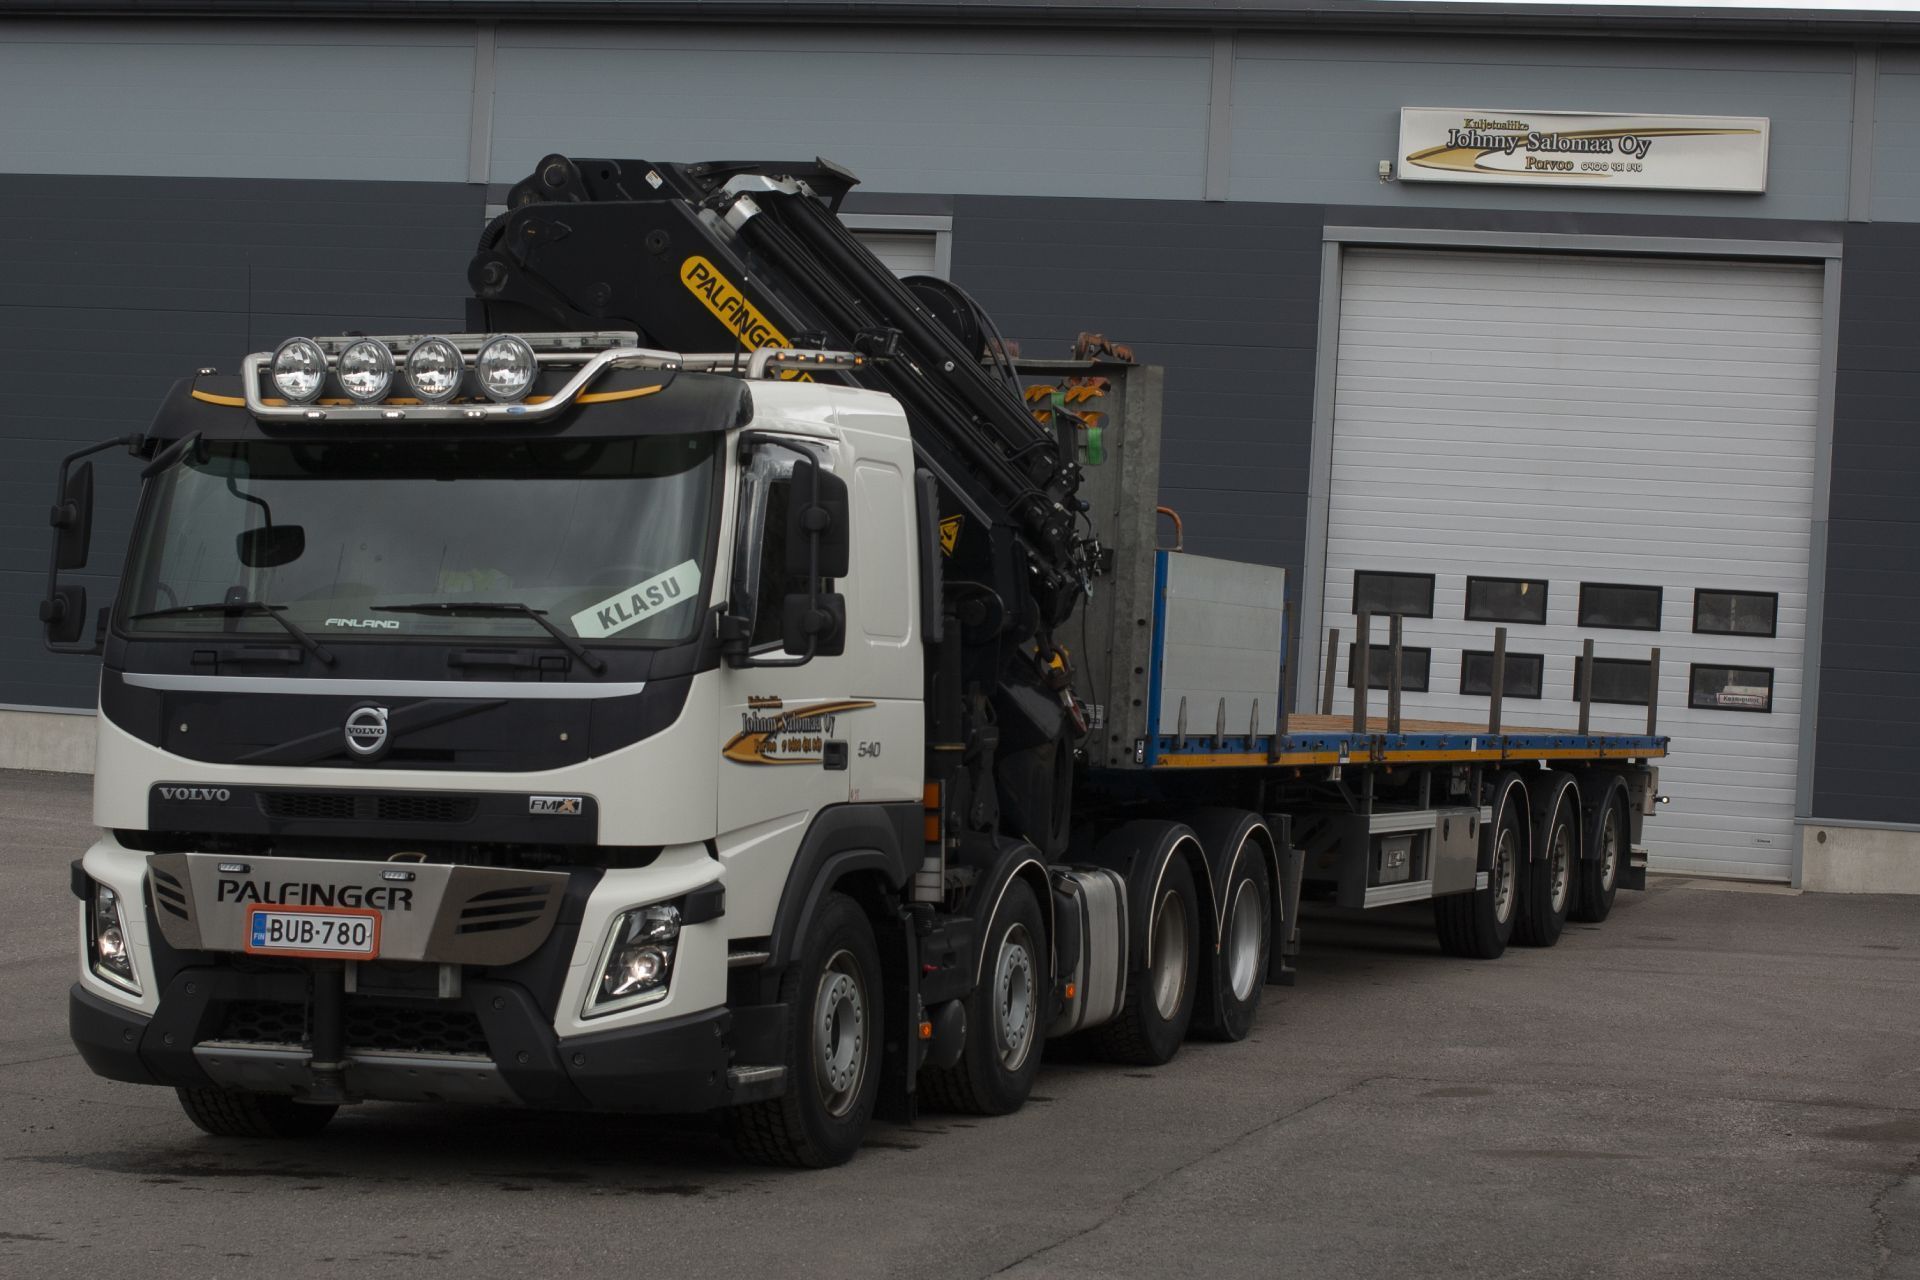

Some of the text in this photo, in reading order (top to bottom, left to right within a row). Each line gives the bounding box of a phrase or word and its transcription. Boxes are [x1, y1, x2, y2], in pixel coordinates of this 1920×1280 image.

[1447, 129, 1651, 159] Johnny Salomaa Oy
[1525, 156, 1574, 171] Porvoo
[1581, 162, 1608, 171] 0400
[687, 262, 790, 349] PALFING
[596, 576, 682, 630] KLASU
[325, 618, 400, 630] FINLAND
[347, 727, 385, 735] VOLVO
[857, 741, 881, 758] 540
[159, 787, 231, 802] VOLVO
[530, 798, 580, 814] FMX
[217, 879, 414, 912] PALFINGER
[253, 932, 265, 941] FIN
[270, 918, 367, 946] BUB-780
